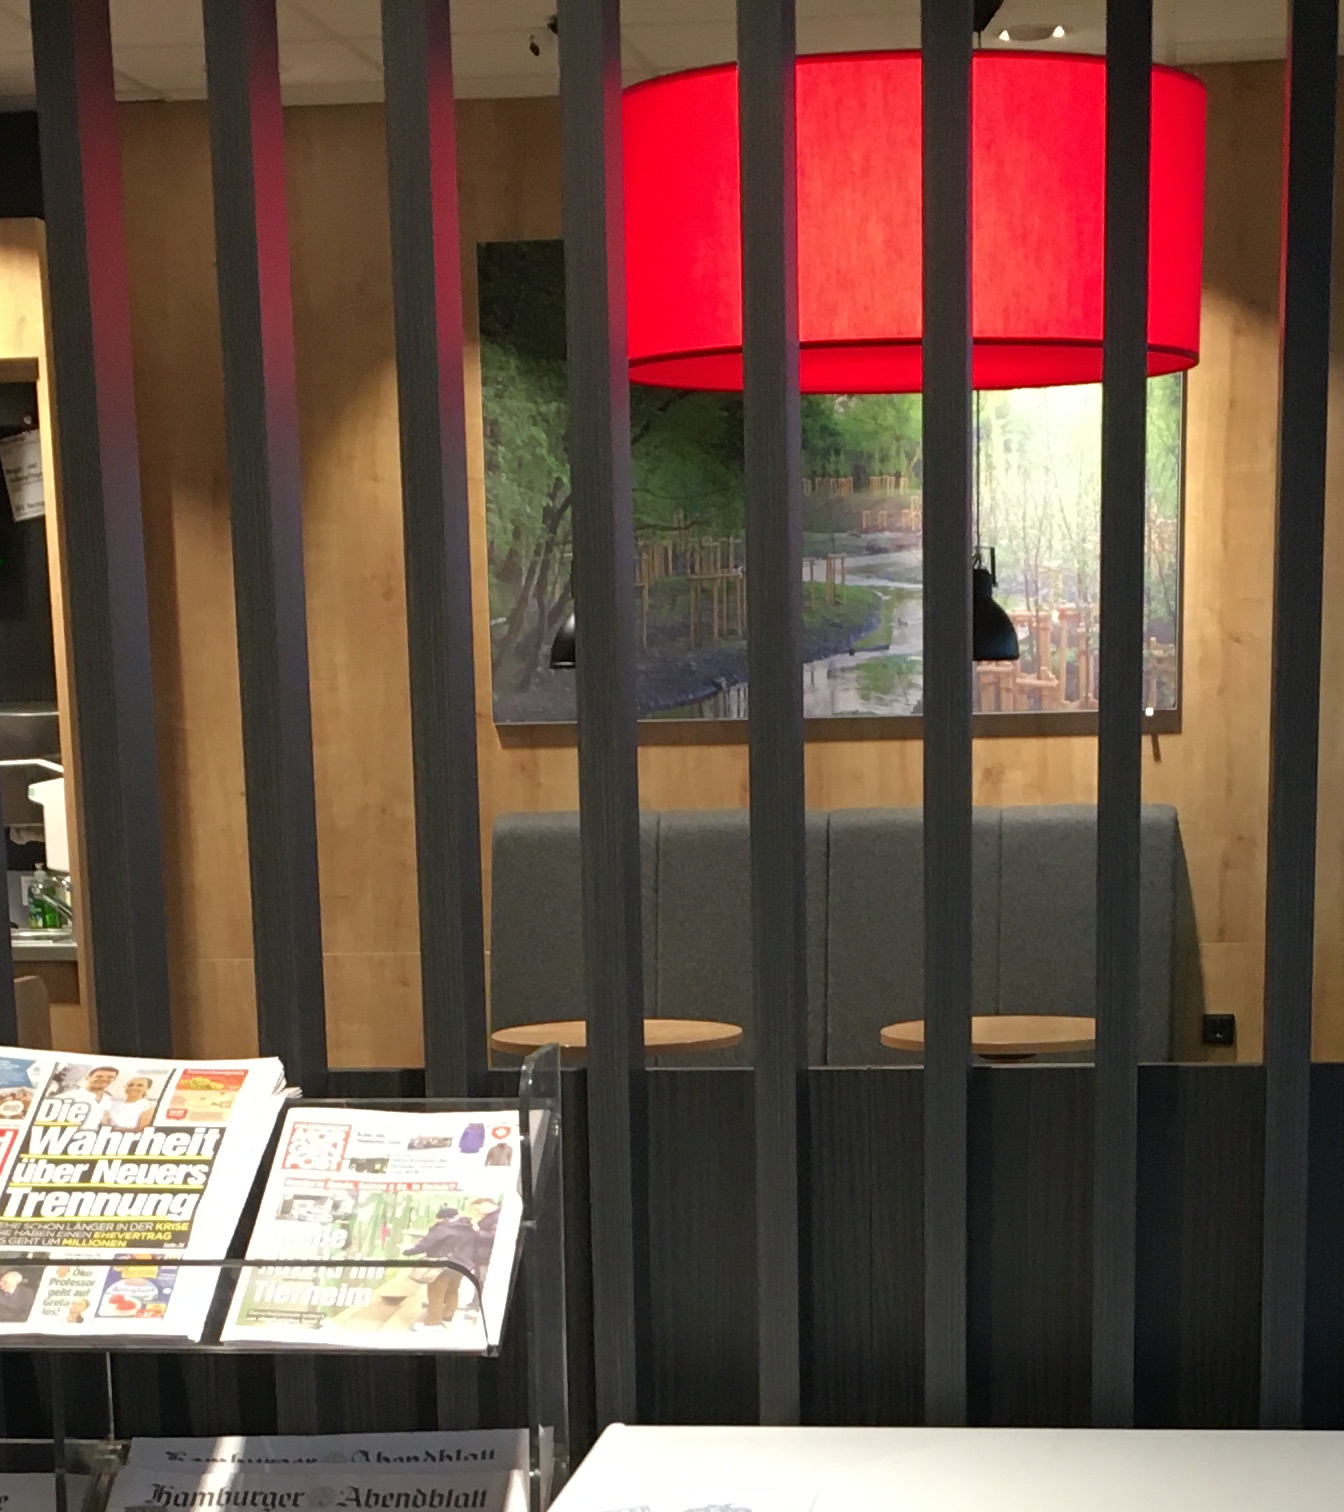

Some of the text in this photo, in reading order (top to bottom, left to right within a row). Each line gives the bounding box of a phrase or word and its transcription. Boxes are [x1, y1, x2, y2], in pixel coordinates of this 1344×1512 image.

[35, 1098, 90, 1124] Die
[28, 1125, 221, 1156] Wahrheit
[12, 1159, 209, 1185] über Neuers
[3, 1188, 200, 1220] Trennung
[14, 1230, 55, 1238] HABEN
[93, 1232, 172, 1240] EHEVERTRAG
[24, 1222, 64, 1230] SCHON
[66, 1222, 114, 1231] LÄNGER
[116, 1222, 127, 1230] IN
[130, 1223, 154, 1231] DER
[155, 1222, 189, 1231] KRISE
[8, 1237, 40, 1245] GEHT
[62, 1238, 127, 1247] MILLIONEN
[49, 1278, 96, 1287] Professor
[254, 1280, 372, 1306] Tierheim
[146, 1483, 488, 1512] Hamburger Abendblatt
